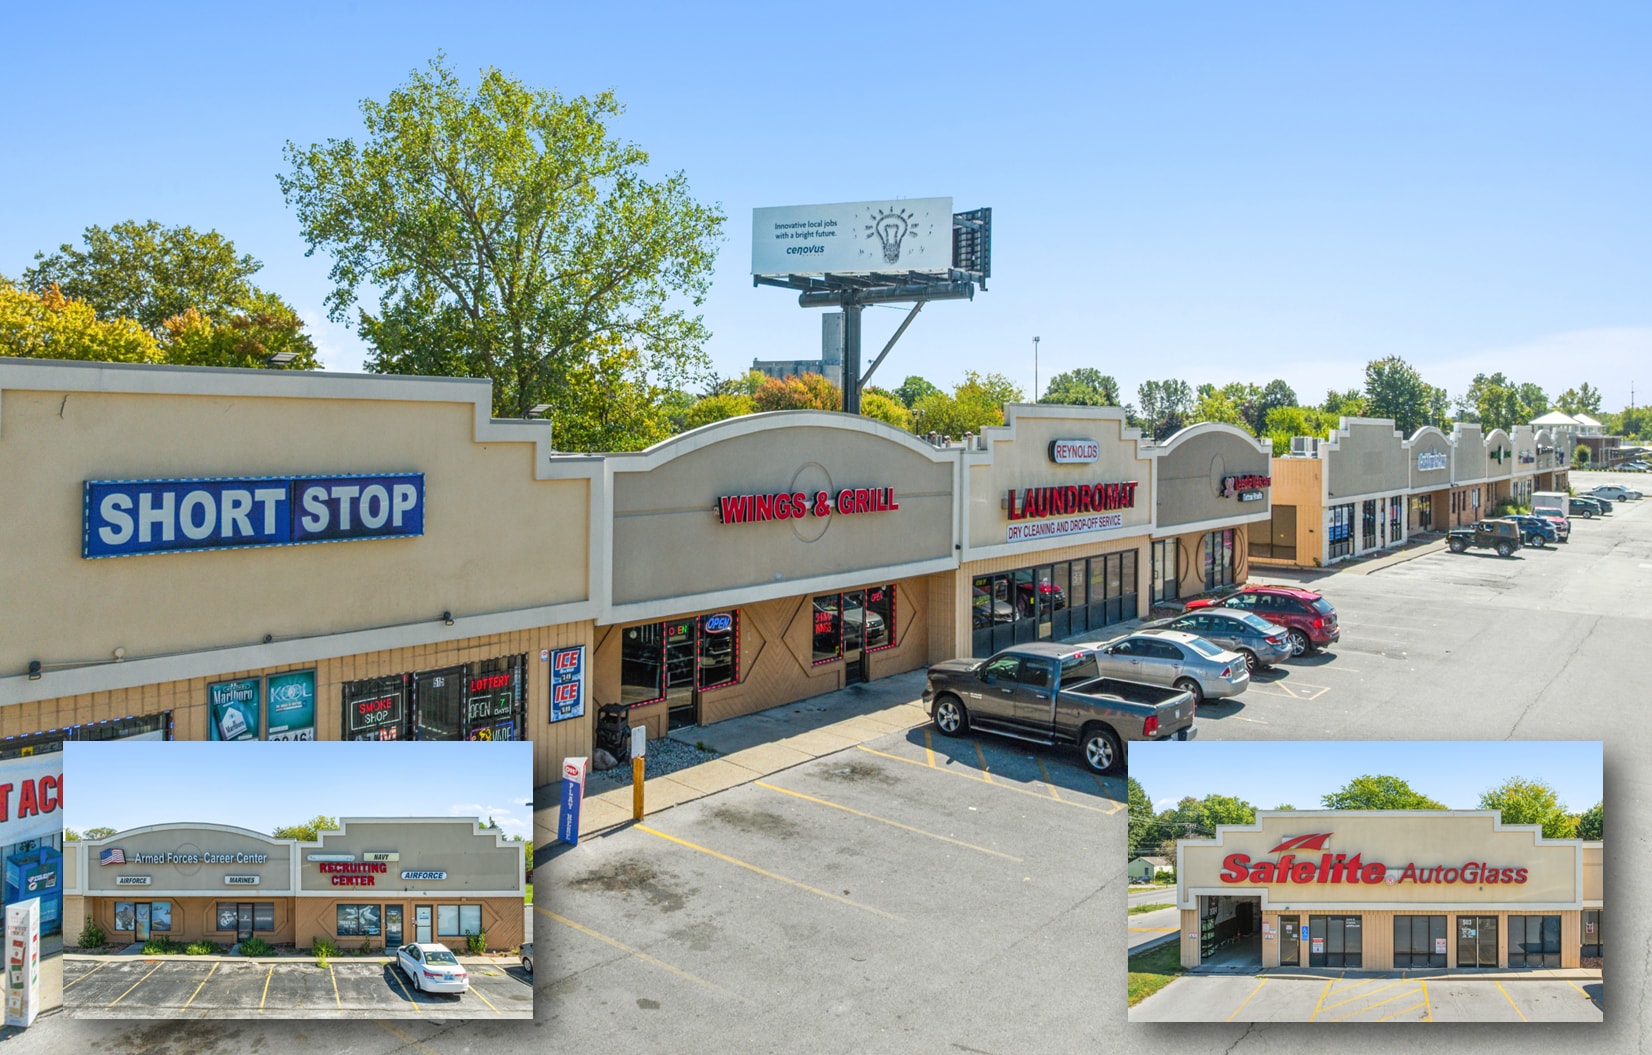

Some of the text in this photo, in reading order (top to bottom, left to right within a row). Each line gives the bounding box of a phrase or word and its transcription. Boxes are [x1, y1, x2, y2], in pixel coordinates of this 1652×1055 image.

[775, 219, 837, 230] Innovative local jobs
[796, 231, 814, 240] bright
[786, 245, 824, 255] cenovus
[1056, 444, 1098, 459] REYNOLDS
[720, 486, 900, 524] WINGS & GRILL
[1008, 481, 1138, 520] LAUNDROMAT
[98, 482, 418, 546] SHORT STOP
[1008, 514, 1122, 540] DRY CLEANING AND DROP-OFF SERVICE
[708, 616, 730, 630] OPEN
[555, 650, 579, 670] ICE
[470, 674, 510, 692] LOTTERY
[214, 689, 254, 706] Marlboro
[270, 682, 312, 703] KOOL
[554, 682, 578, 703] ICE
[359, 698, 392, 714] SMOKE
[499, 697, 506, 707] 7
[365, 711, 388, 724] SHOP
[494, 706, 510, 716] DAYS
[135, 852, 268, 864] Armed Forces Career Center
[373, 853, 389, 861] NAVY
[319, 862, 387, 874] RECRUITING
[1220, 852, 1529, 885] Safelite AutoGlass
[119, 876, 147, 884] AIRFORCE
[229, 876, 255, 884] MARINES
[331, 875, 375, 886] CENTER
[404, 871, 444, 880] AIRFORCE
